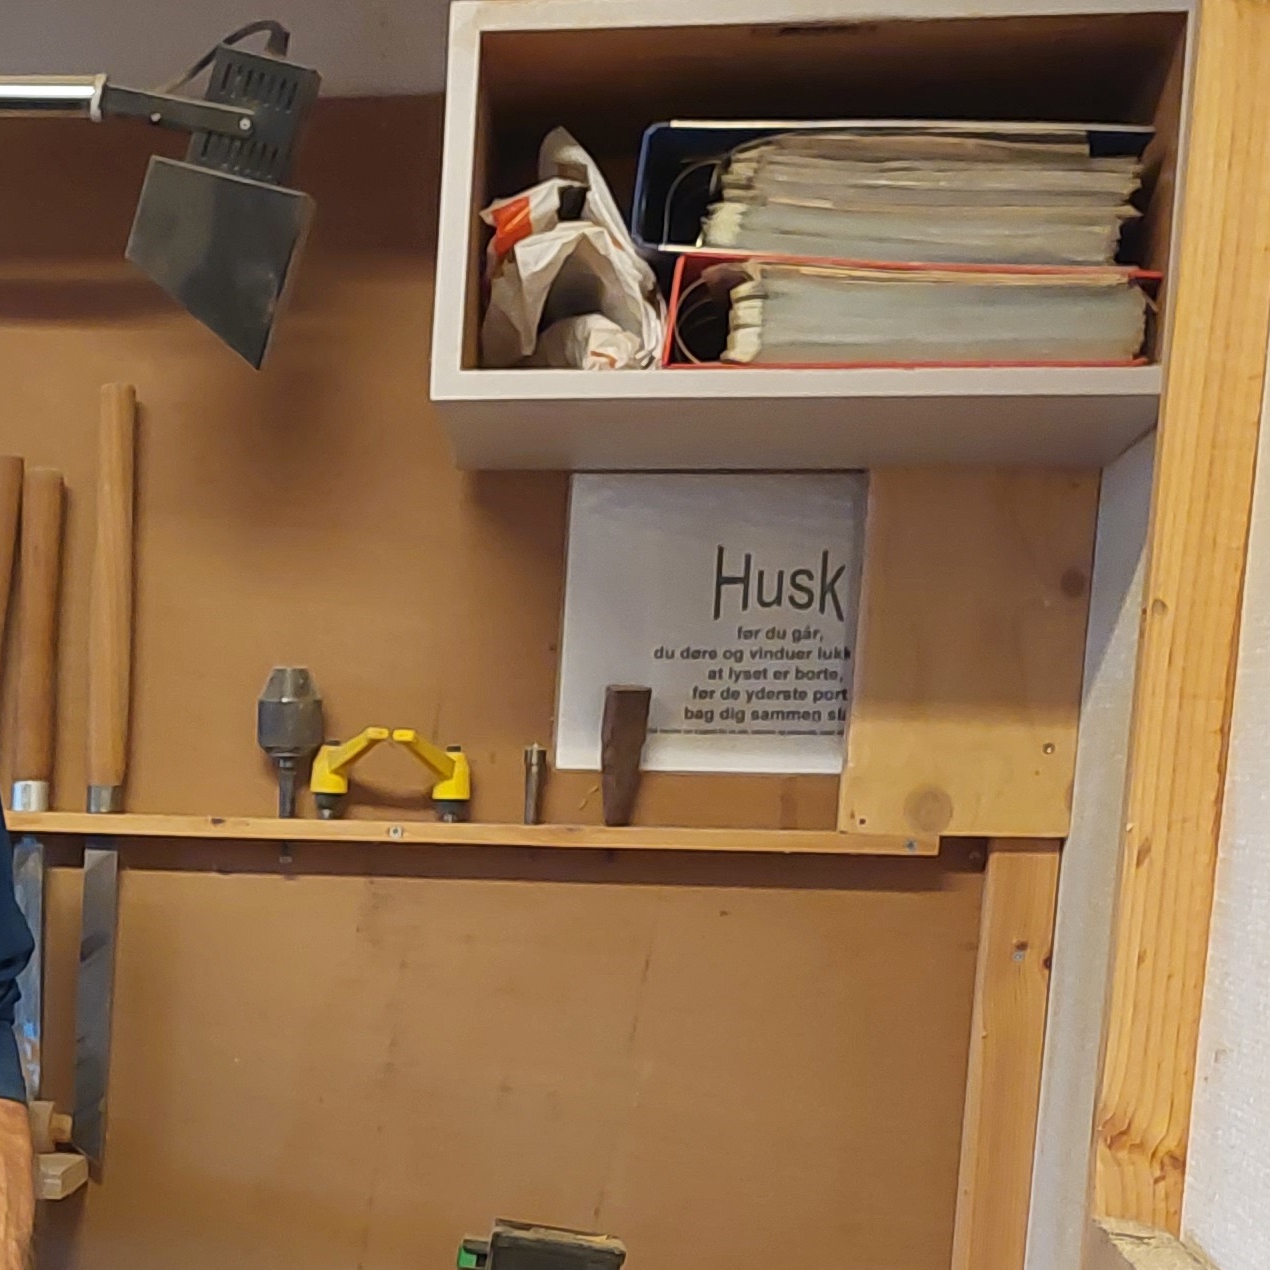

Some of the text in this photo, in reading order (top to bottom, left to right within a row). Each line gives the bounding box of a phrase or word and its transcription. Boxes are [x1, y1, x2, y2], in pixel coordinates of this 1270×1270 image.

[713, 545, 846, 622] Husk
[736, 625, 761, 641] før
[765, 626, 787, 641] du
[653, 645, 675, 660] du
[679, 646, 718, 660] døre
[722, 648, 744, 663] og
[749, 646, 813, 660] vinduer
[707, 667, 723, 681] at
[728, 666, 768, 683] lyset
[772, 668, 790, 681] er
[692, 685, 716, 700] før
[719, 686, 740, 700] de
[745, 687, 808, 704] yderste
[683, 705, 714, 724] bag
[718, 706, 746, 724] dig
[750, 709, 822, 722] sammen
